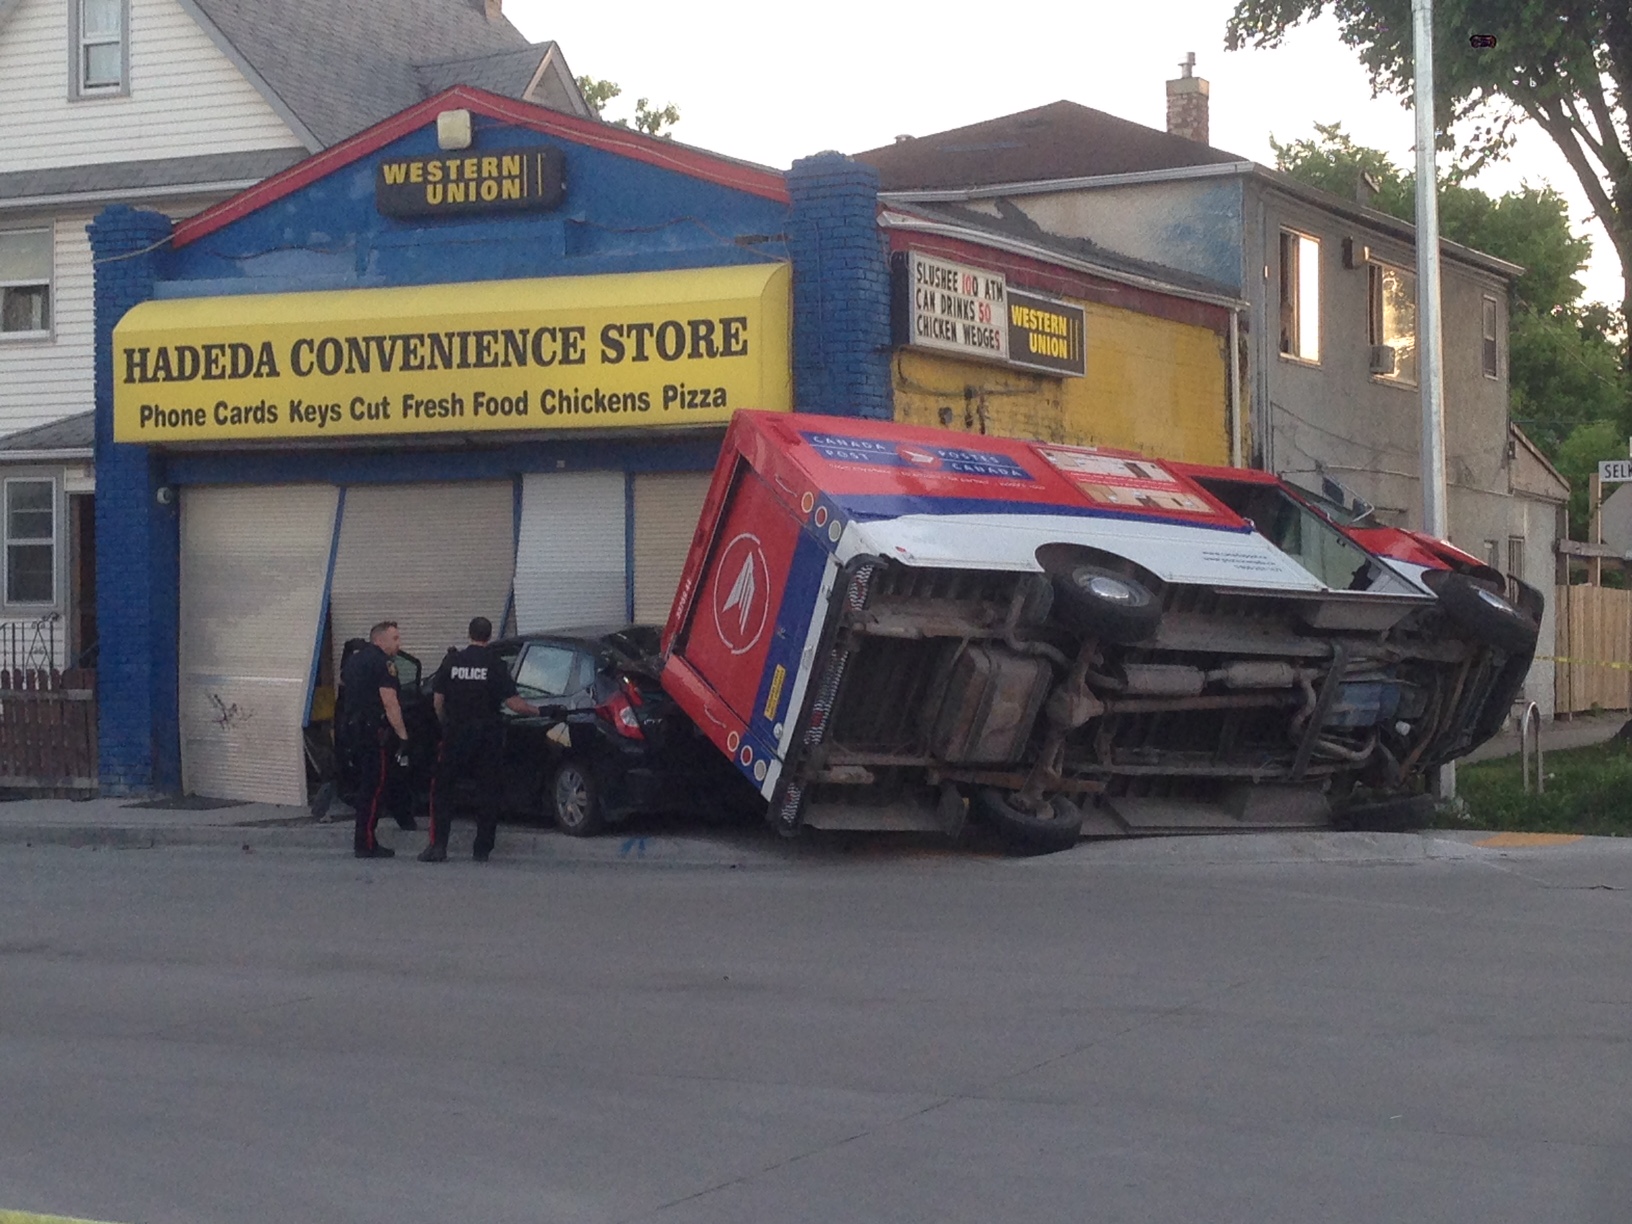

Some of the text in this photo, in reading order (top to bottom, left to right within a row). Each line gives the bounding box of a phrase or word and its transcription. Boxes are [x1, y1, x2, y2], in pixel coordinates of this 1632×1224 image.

[383, 154, 520, 185] WESTERN
[426, 178, 520, 205] UNION
[916, 262, 1003, 302] SLUSHEE 100 ATM
[916, 288, 991, 323] CAN DRINKS 50
[1010, 304, 1067, 336] WESTERN
[916, 314, 1000, 350] CHICKEN WEDGES
[1029, 333, 1068, 359] UNION
[123, 316, 748, 384] HADEDA CONVENIENCE STORE
[140, 382, 727, 428] Phone Cards Keys Cut Fresh Food Chickens Pizza
[813, 435, 886, 451] CANADA
[825, 449, 870, 461] POST
[938, 450, 999, 464] POSTES
[952, 462, 1022, 477] CANADA
[450, 666, 488, 680] POLICE
